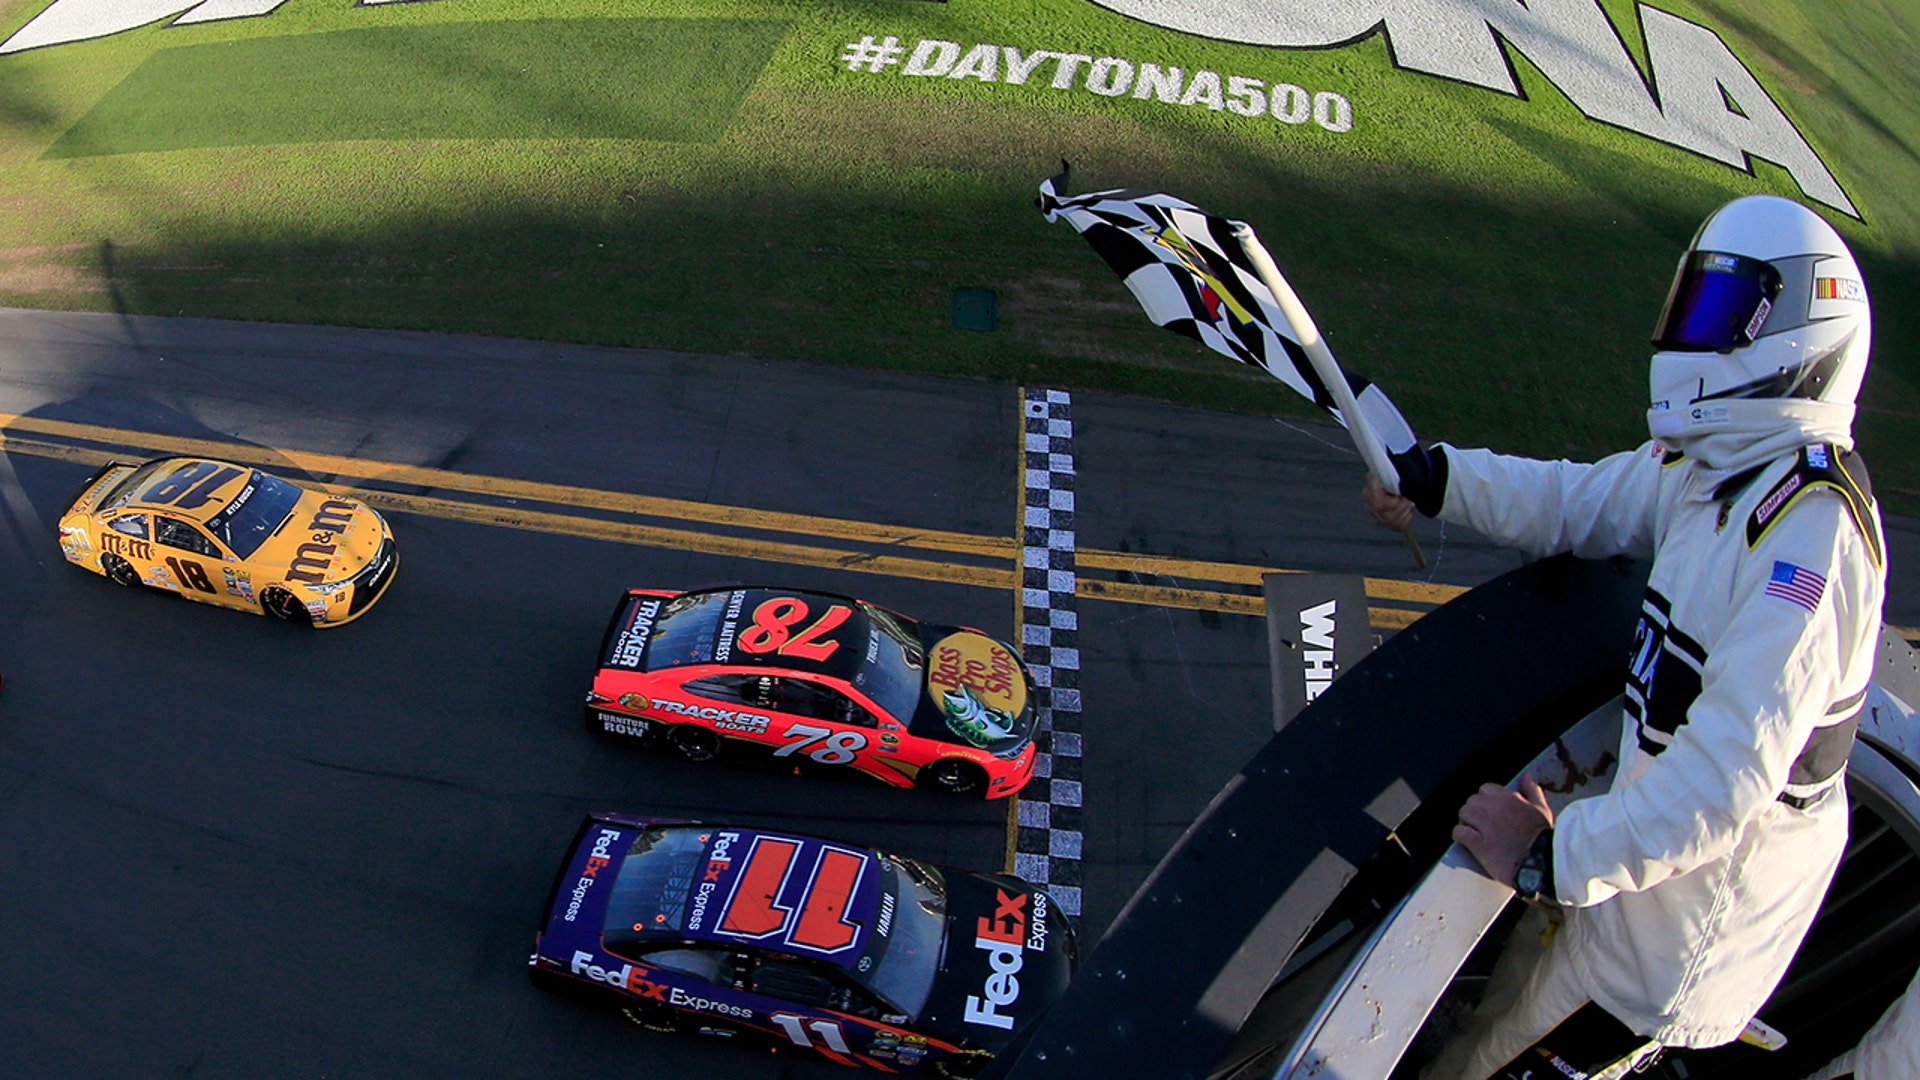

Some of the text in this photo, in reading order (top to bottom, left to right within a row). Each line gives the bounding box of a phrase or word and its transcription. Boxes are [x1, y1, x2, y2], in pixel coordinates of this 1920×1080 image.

[842, 34, 1355, 133] #DAYTONA500
[141, 461, 245, 509] 18
[1759, 477, 1798, 520] SIMPSON
[165, 556, 218, 595] 18
[611, 630, 630, 664] boats
[619, 601, 661, 667] TRACKER
[715, 620, 738, 662] MATTRESS
[737, 597, 853, 662] 78
[931, 646, 961, 690] Bass
[959, 660, 986, 693] Pro
[985, 647, 1018, 700] Shops
[598, 713, 649, 731] FURNITURE
[604, 722, 645, 737] ROW
[651, 698, 771, 728] TRACKER
[715, 721, 766, 734] BOATS
[773, 723, 867, 764] 78
[565, 829, 621, 922] FedEx Express
[688, 832, 740, 930] FedEx Express
[713, 834, 868, 955] 11
[876, 892, 896, 937] HAMLIN
[964, 888, 1049, 1030] FedEx Express
[571, 950, 752, 1018] FedEx Express
[771, 1013, 851, 1054] 11
